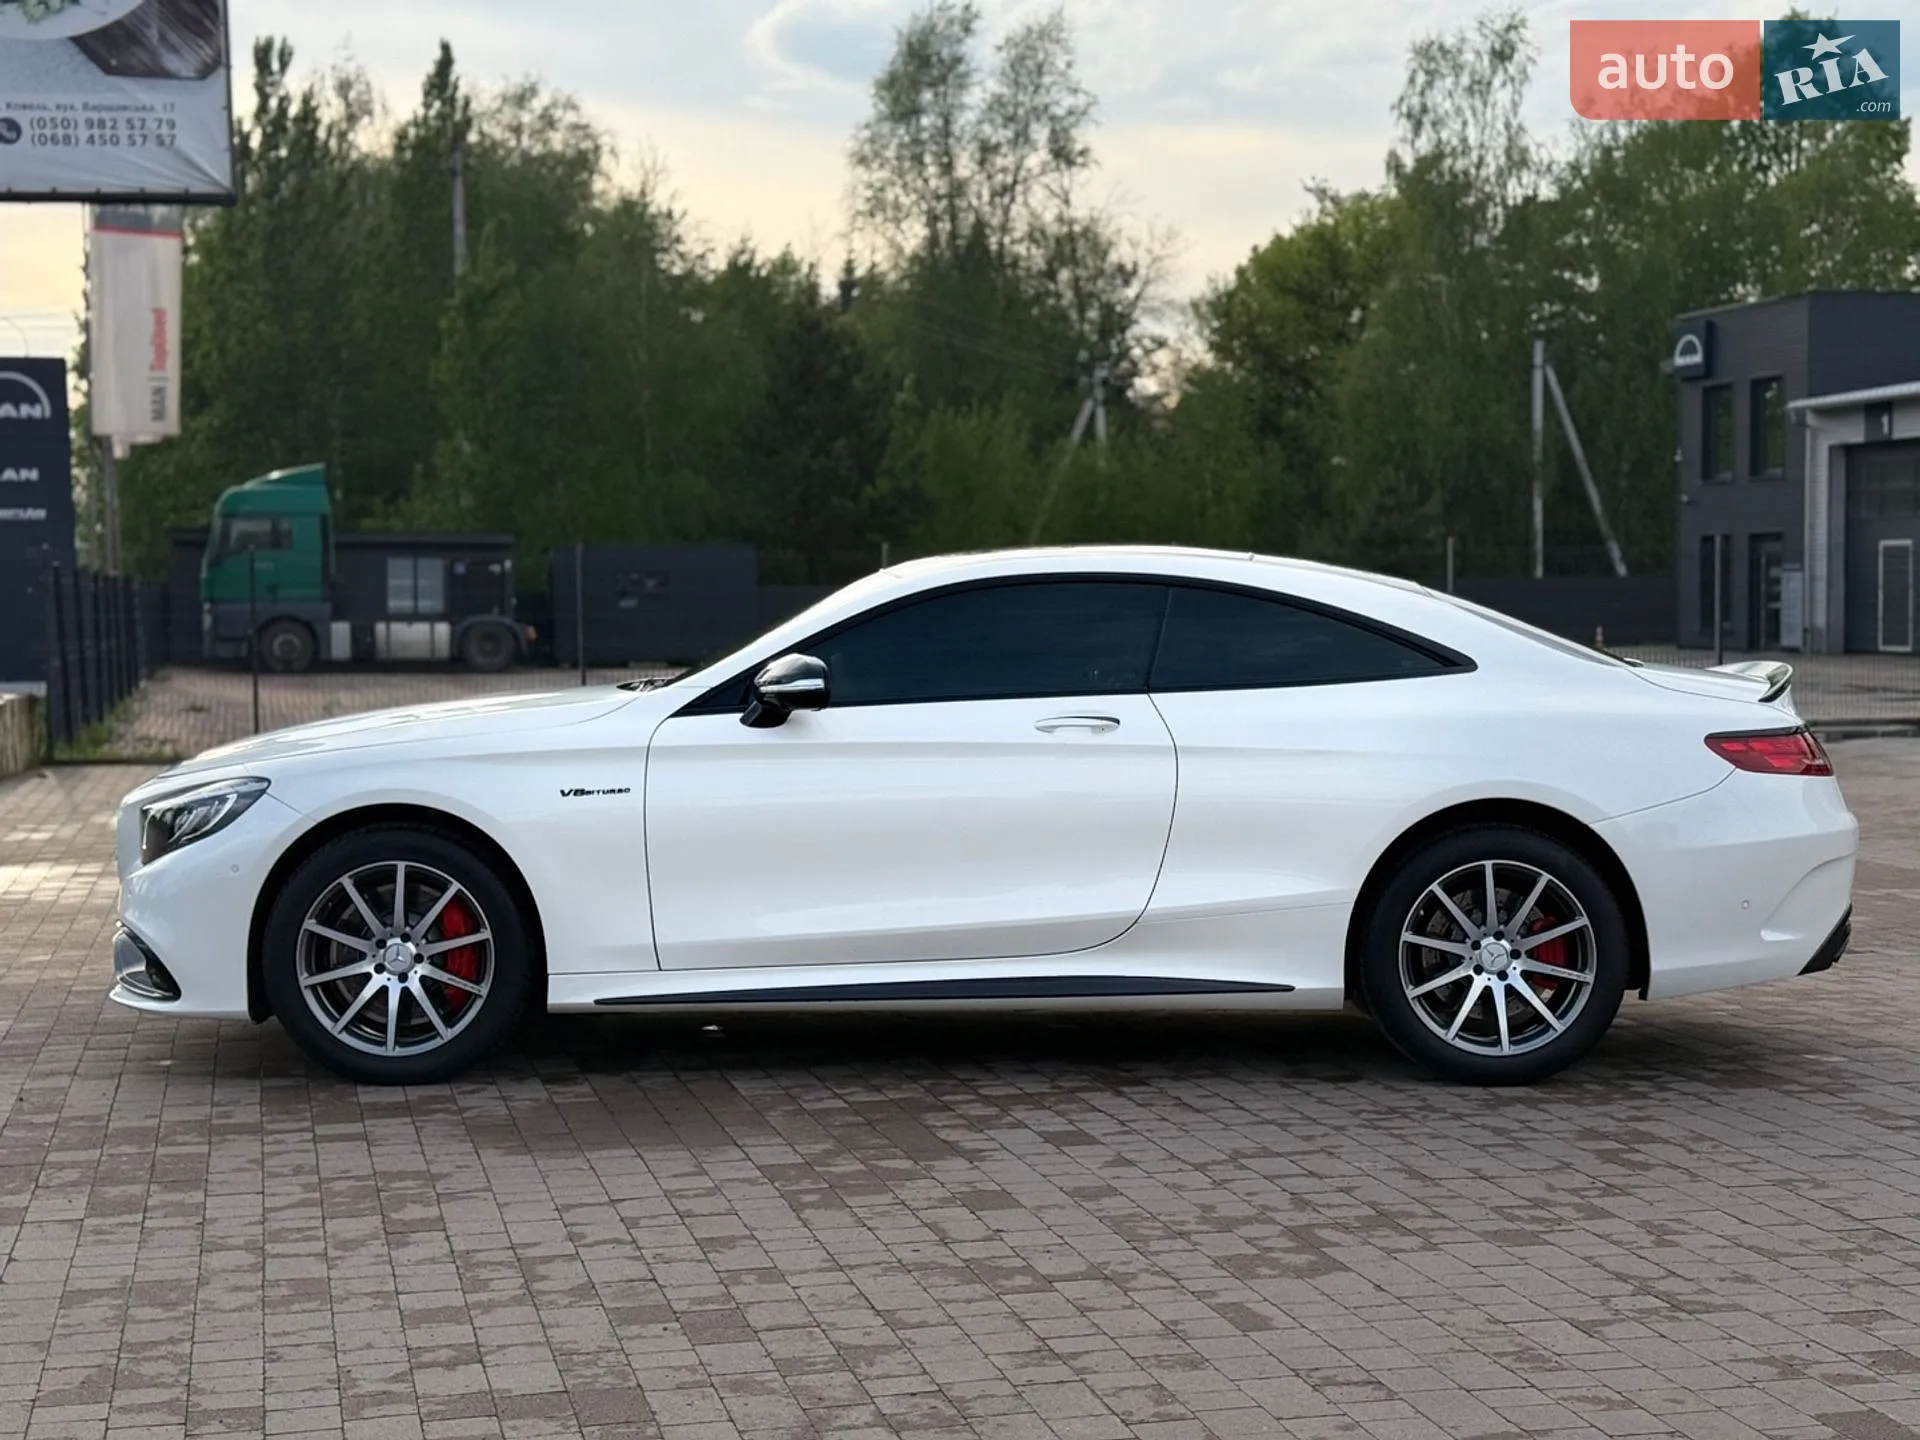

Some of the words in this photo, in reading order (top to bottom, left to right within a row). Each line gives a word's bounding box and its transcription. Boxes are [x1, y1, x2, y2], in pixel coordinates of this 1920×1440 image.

[29, 116, 78, 131] (050)
[84, 117, 118, 130] 982
[125, 117, 147, 130] 57
[153, 117, 177, 130] 79
[85, 133, 120, 147] 450
[127, 133, 148, 147] 57
[155, 133, 177, 147] 57
